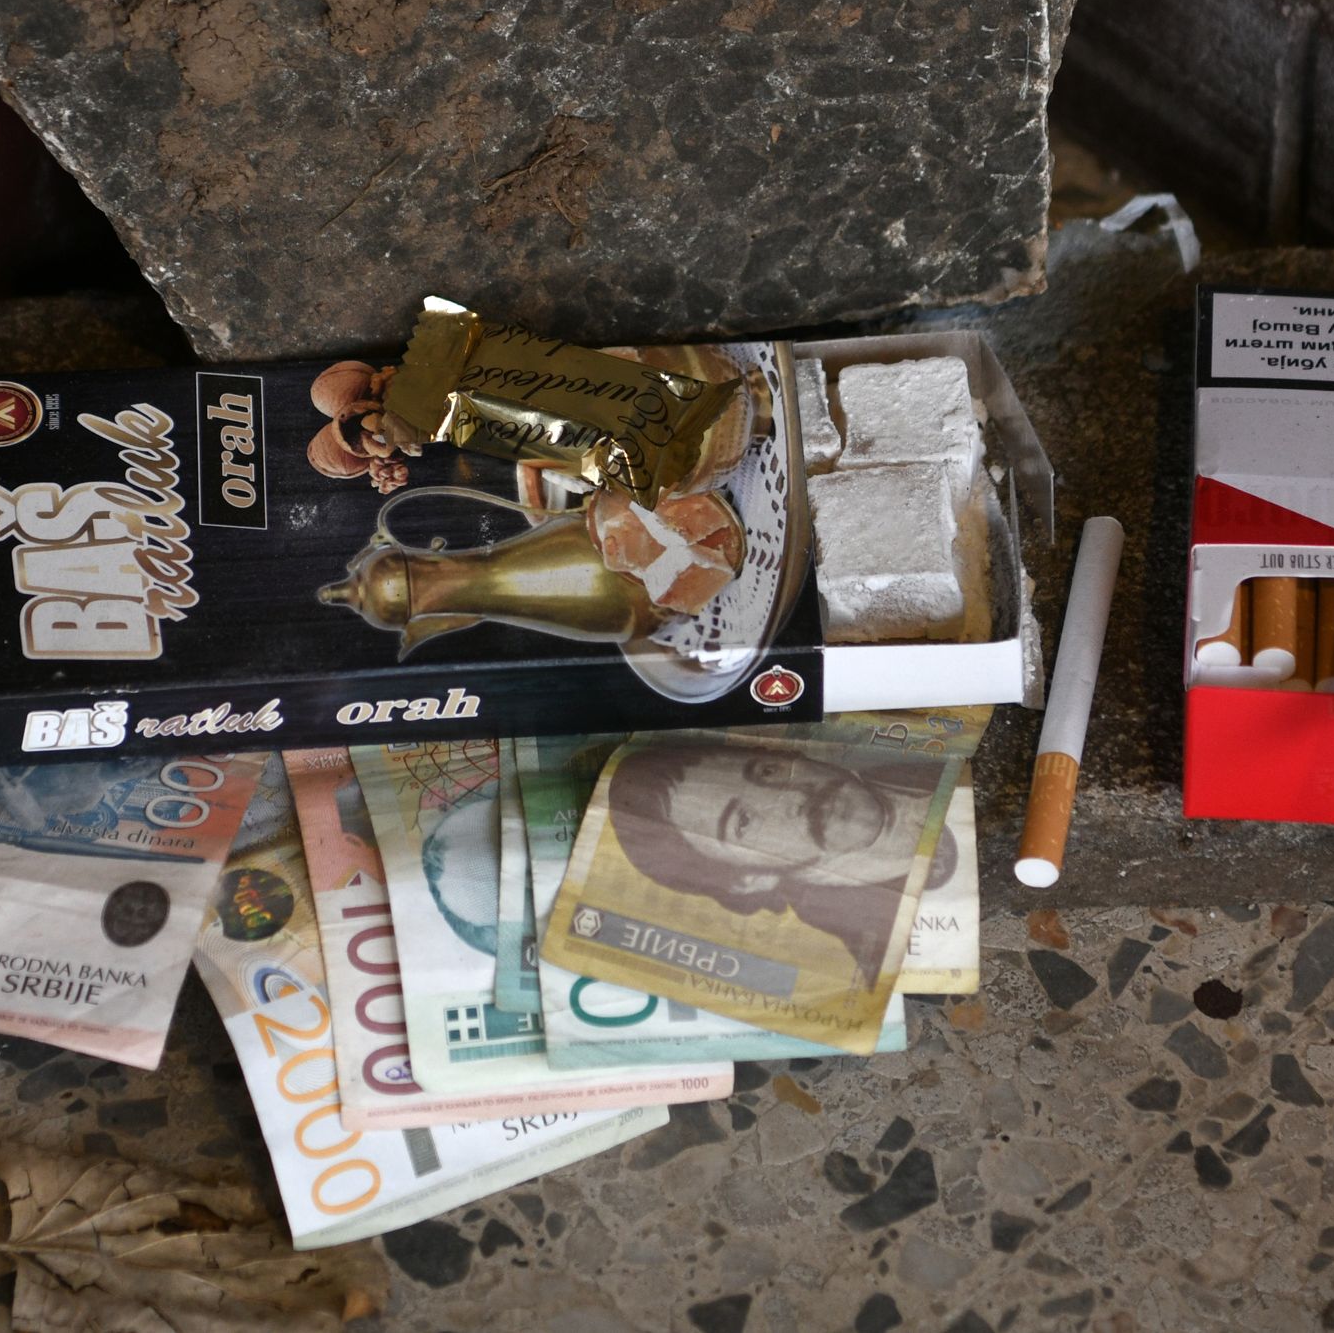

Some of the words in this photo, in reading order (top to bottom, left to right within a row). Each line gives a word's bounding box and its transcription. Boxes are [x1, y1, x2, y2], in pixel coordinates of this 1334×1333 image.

[1251, 319, 1320, 336] Вашој
[1224, 337, 1294, 351] штети
[1260, 354, 1328, 371] убија.
[207, 393, 257, 510] orah
[77, 402, 199, 622] ratluk
[1288, 553, 1320, 570] STUB
[22, 700, 129, 753] BAŠ
[136, 697, 283, 740] ratluk
[336, 688, 481, 726] orah
[51, 820, 121, 841] dvesta
[127, 827, 196, 850] dinara
[912, 916, 960, 931] NKA
[620, 923, 741, 976] СРБИЈЕ
[78, 964, 148, 989] BANKA
[0, 975, 105, 1006] SRBIJE
[680, 1077, 709, 1091] 1000
[254, 993, 382, 1216] 2000
